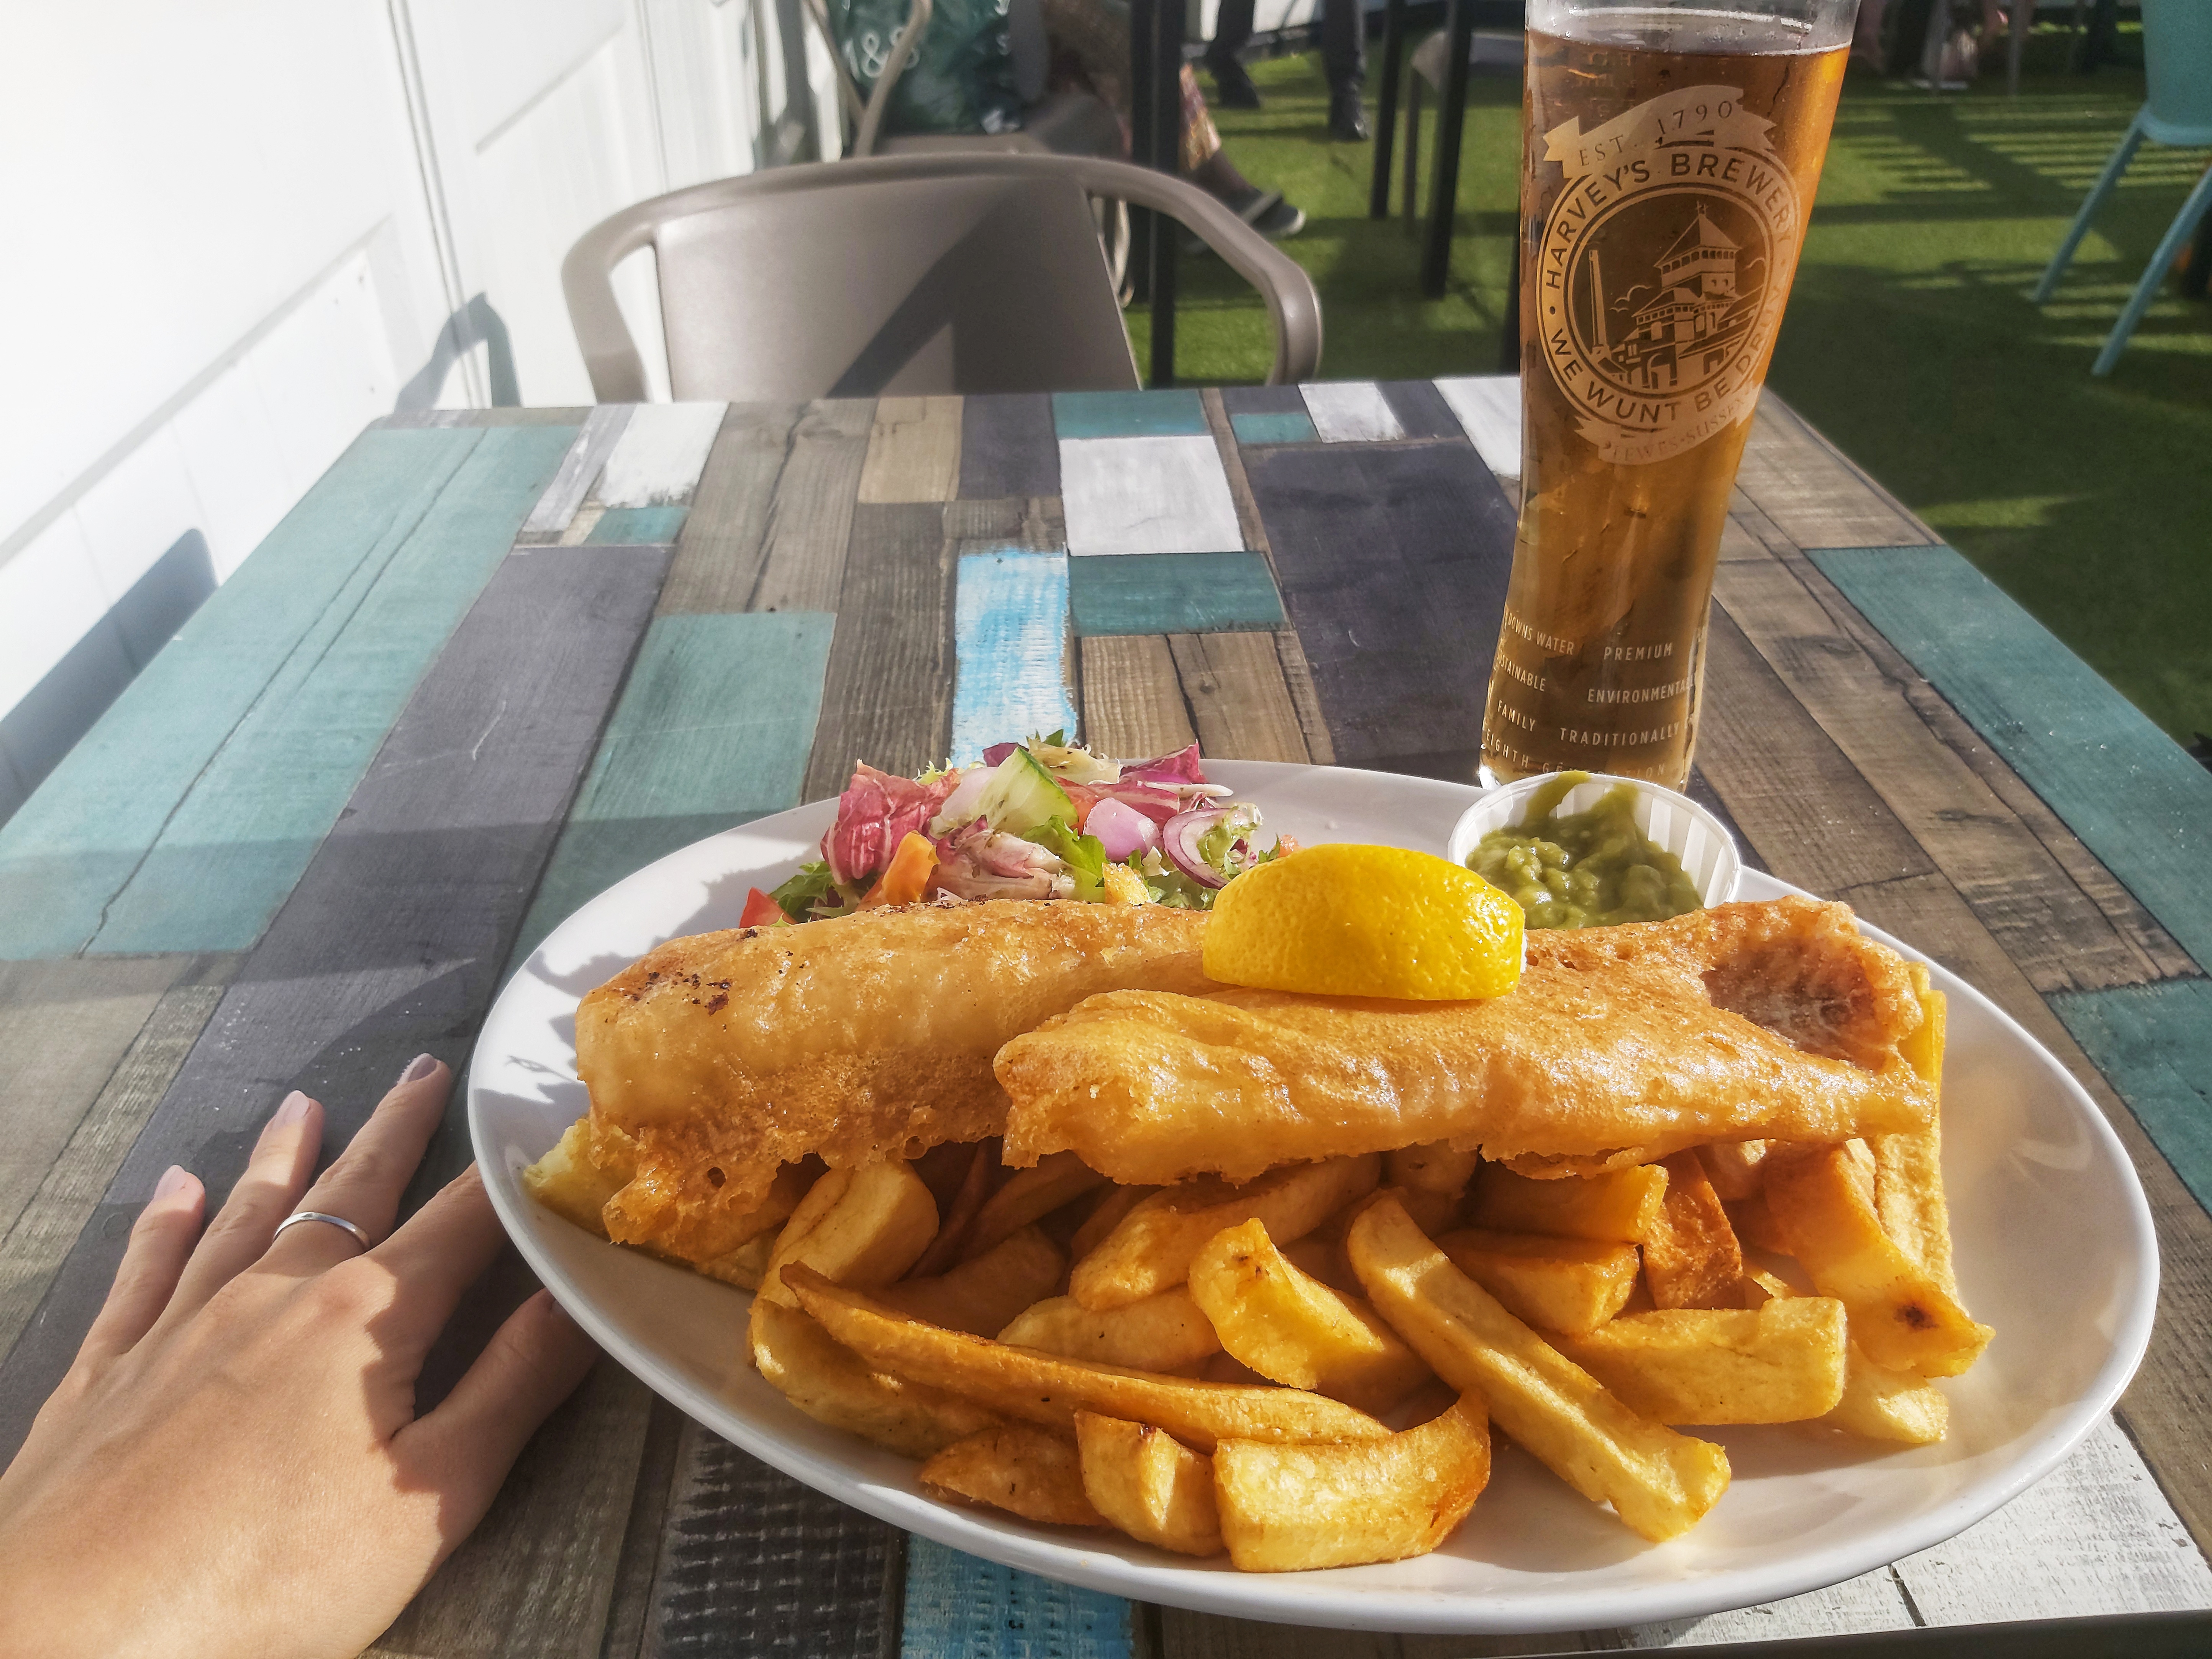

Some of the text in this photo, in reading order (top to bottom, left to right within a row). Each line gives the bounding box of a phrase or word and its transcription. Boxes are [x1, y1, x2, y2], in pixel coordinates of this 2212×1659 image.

[1658, 101, 1732, 134] 1790
[1546, 153, 1792, 289] HARVEY'S BREWERY
[1550, 288, 1782, 423] WE WUNT BE DRUV
[1508, 612, 1533, 641] DOWNS
[1536, 631, 1574, 655] WATER
[1604, 642, 1673, 661] PREMIUM
[1497, 700, 1536, 732] FAMILY
[1560, 721, 1681, 746] TRADITIONALLY
[1486, 728, 1530, 768] EIGHTH
